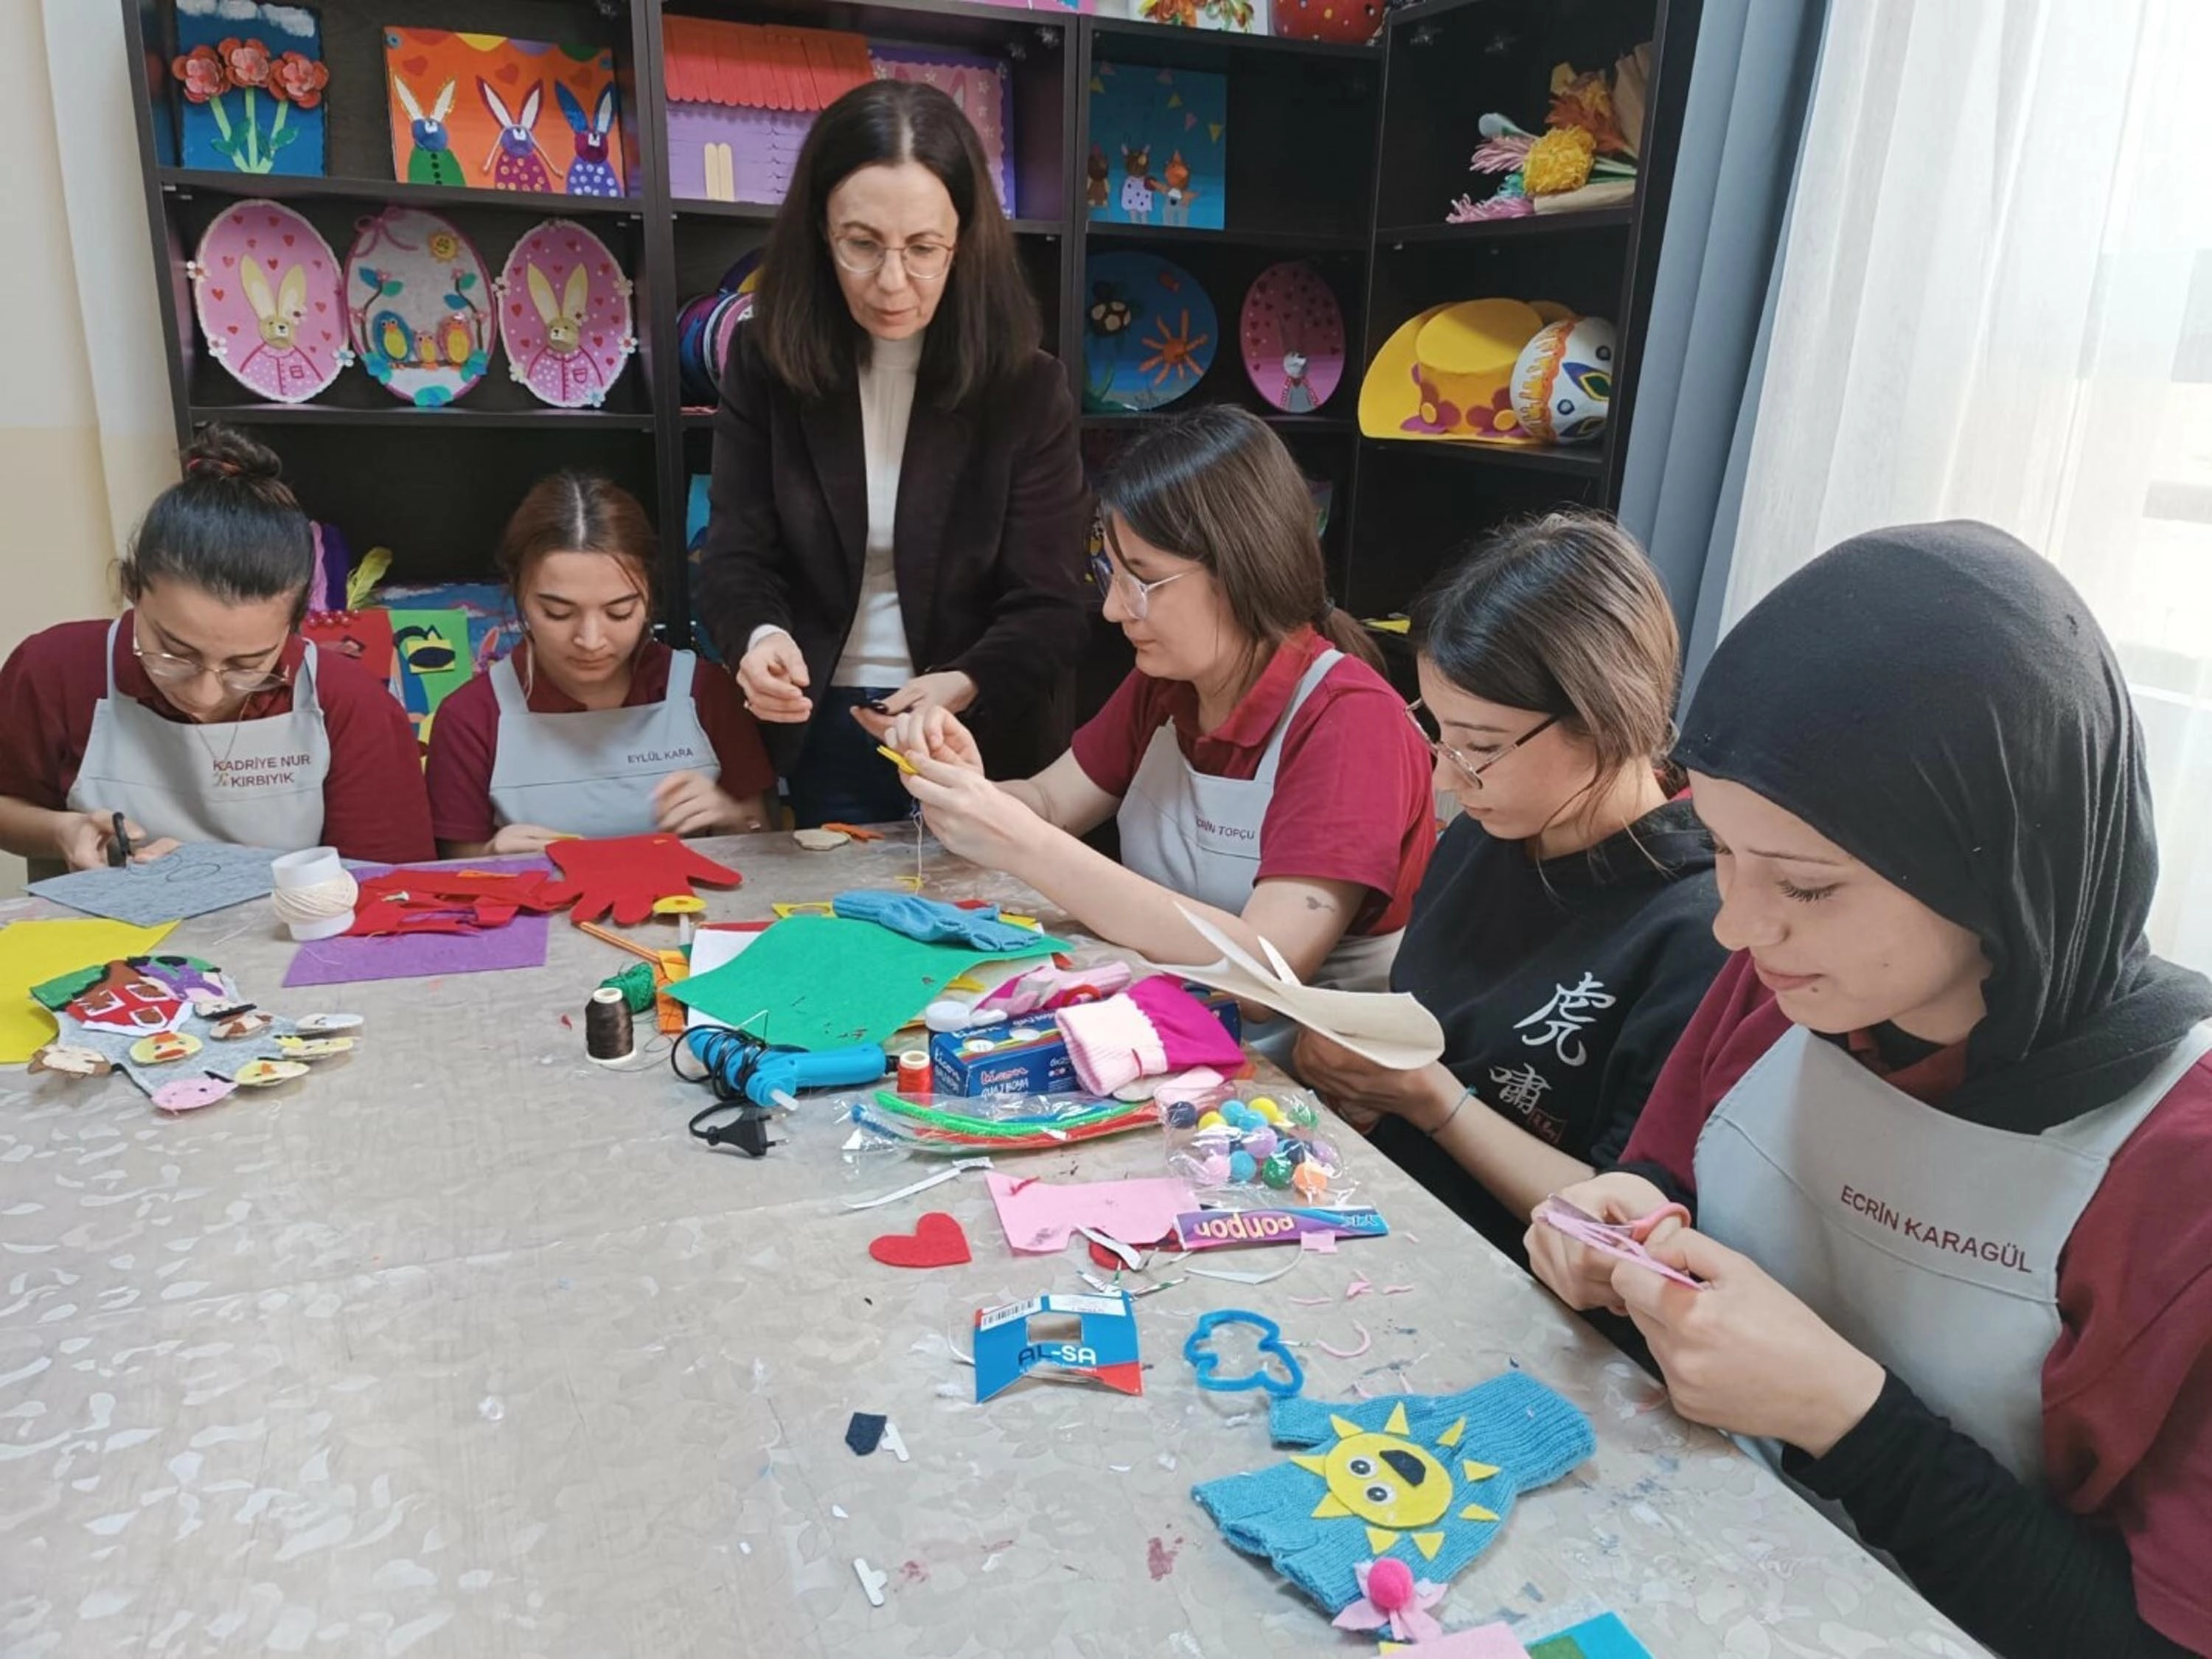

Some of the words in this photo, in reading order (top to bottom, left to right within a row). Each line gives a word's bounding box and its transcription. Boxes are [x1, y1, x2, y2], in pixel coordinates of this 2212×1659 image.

[213, 756, 277, 771] KADRİYE
[280, 754, 310, 767] NUR
[627, 751, 662, 763] EYLÜL
[664, 748, 693, 760] KARA
[231, 773, 295, 787] KIRBIYIK
[1218, 825, 1254, 840] TOPÇU
[1193, 1212, 1295, 1239] ponpon
[1840, 1184, 1900, 1231] ECRİN
[1904, 1217, 2032, 1273] KARAGÜL
[1018, 1345, 1097, 1366] AL-SA
